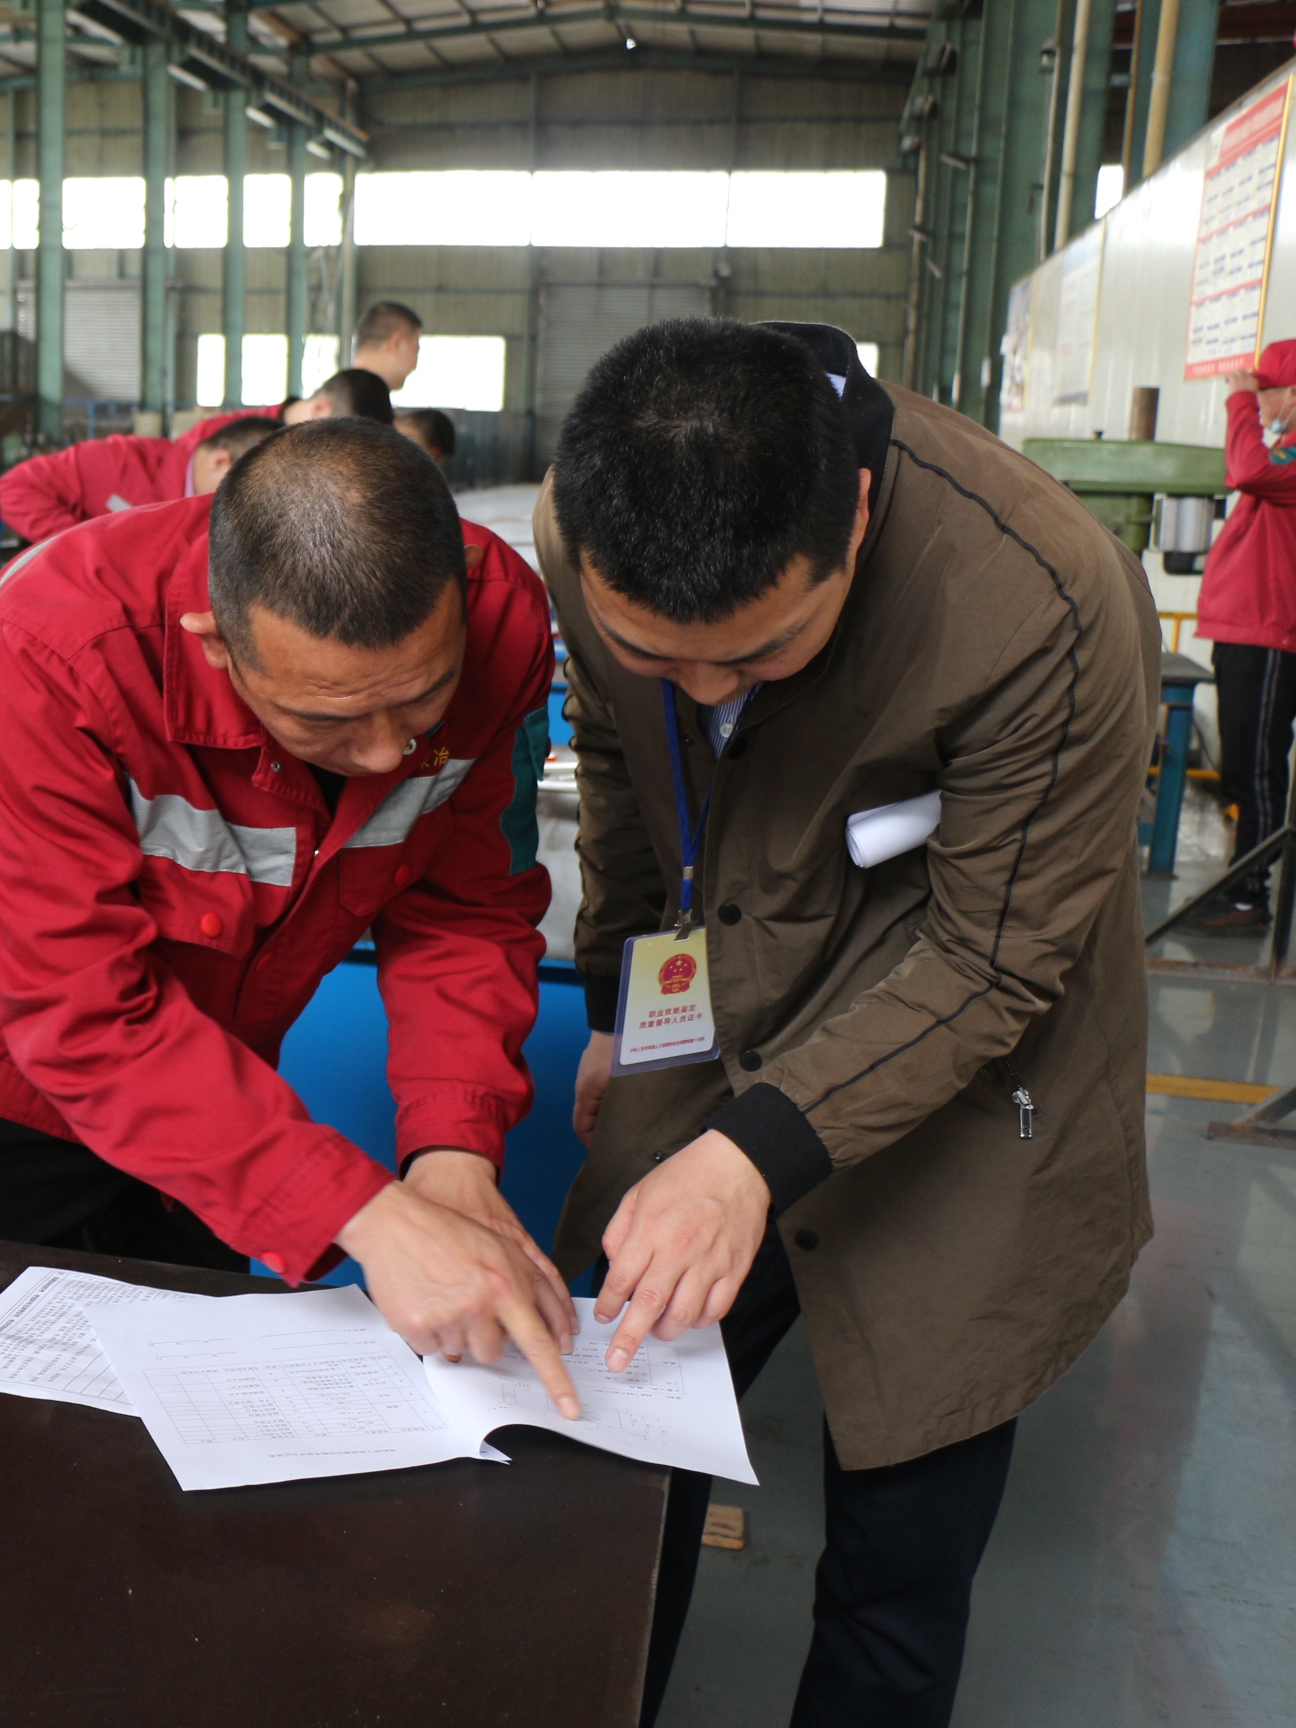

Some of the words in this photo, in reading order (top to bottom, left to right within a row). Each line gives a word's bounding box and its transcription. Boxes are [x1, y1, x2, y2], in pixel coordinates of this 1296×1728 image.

[648, 1004, 696, 1018] 职业技能鉴定
[639, 1012, 702, 1029] 质量督导人员证卡
